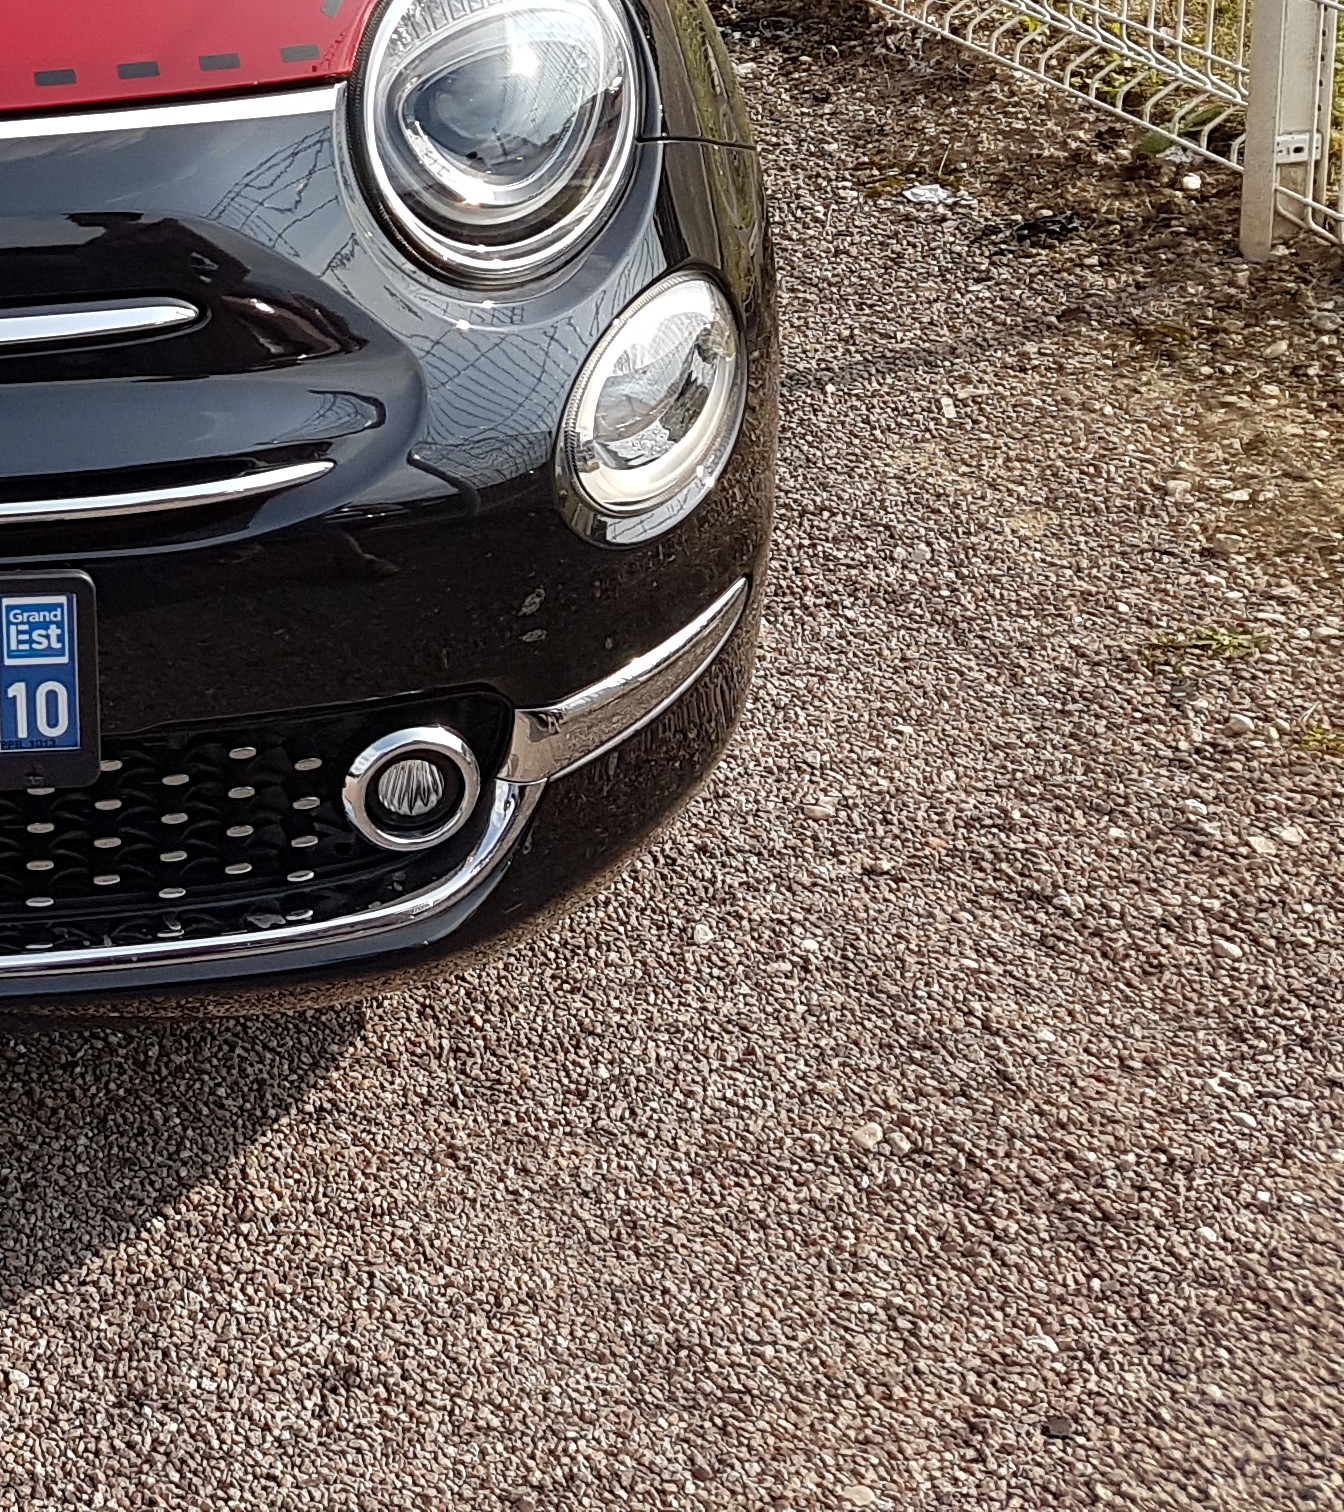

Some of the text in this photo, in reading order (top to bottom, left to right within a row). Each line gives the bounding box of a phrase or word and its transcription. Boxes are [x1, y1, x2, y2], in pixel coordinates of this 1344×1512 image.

[9, 607, 62, 623] Grand
[9, 624, 63, 651] Est
[7, 680, 69, 739] 10
